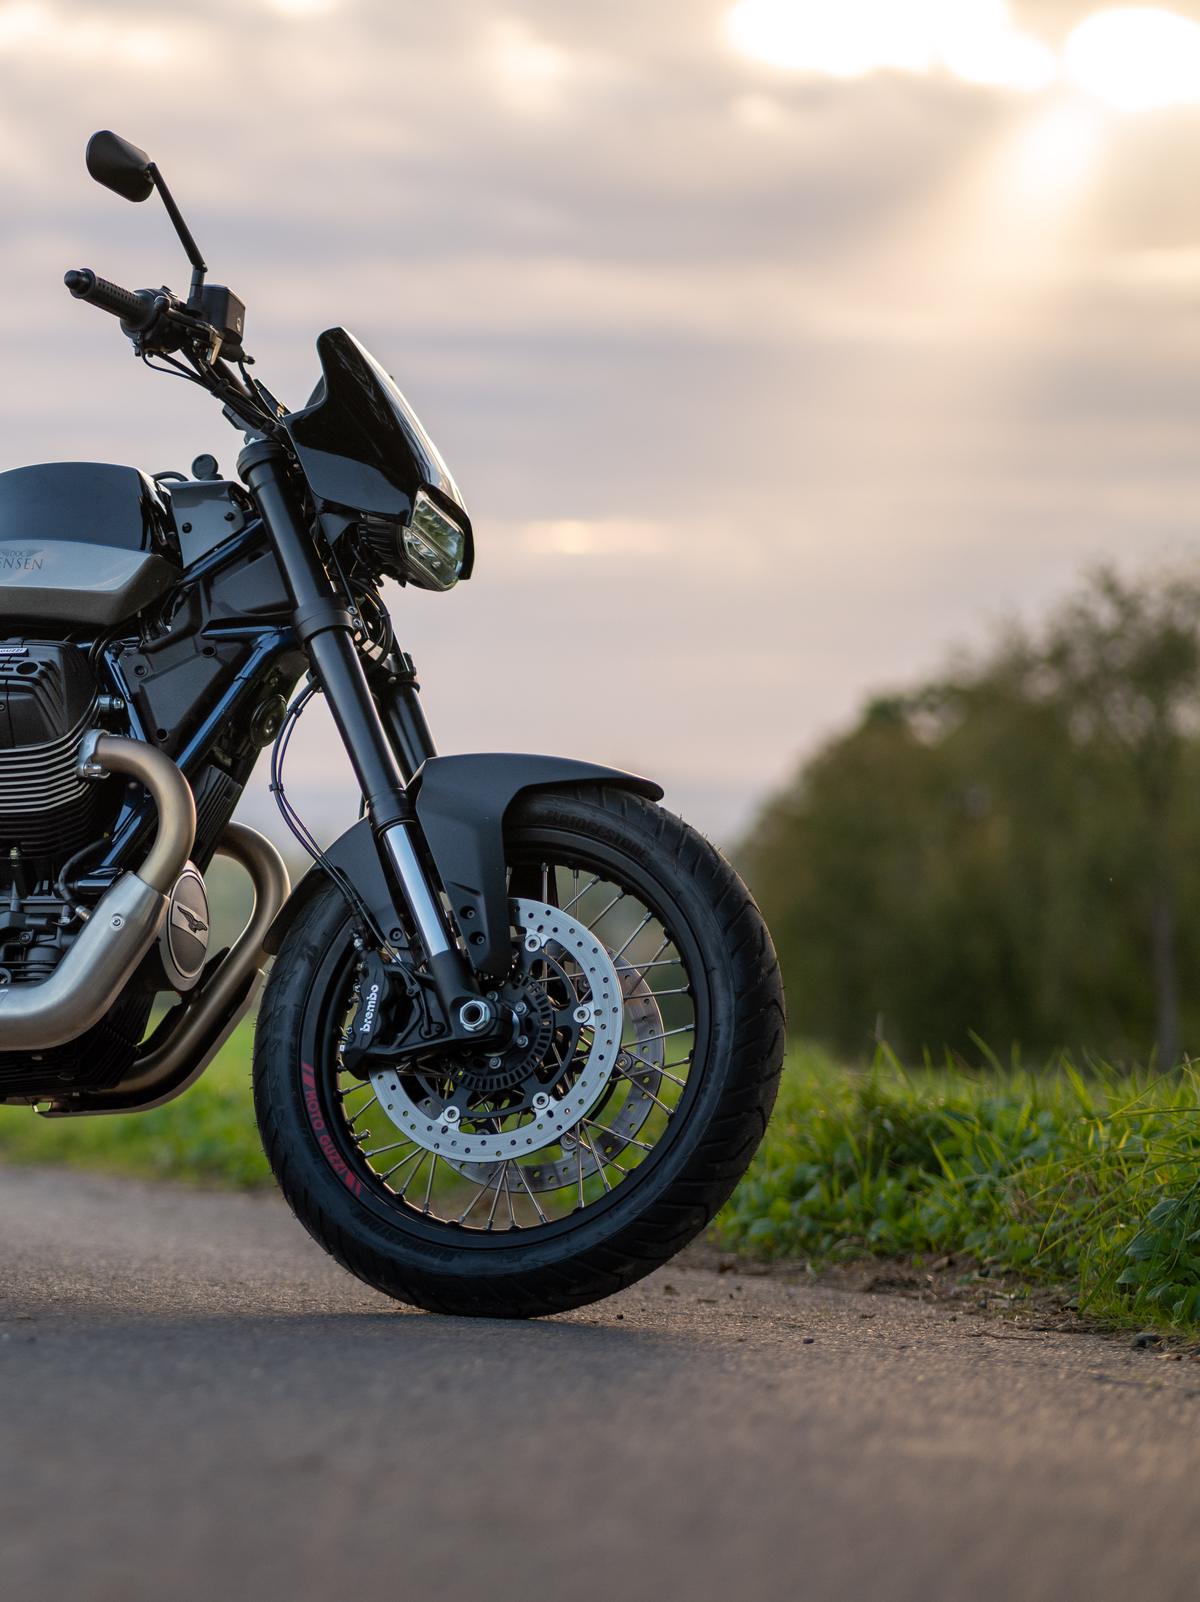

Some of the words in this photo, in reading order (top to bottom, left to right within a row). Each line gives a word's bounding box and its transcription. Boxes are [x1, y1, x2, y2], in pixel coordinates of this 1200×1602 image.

[360, 984, 379, 1032] brembo
[305, 1090, 324, 1130] MOTO
[320, 1135, 348, 1174] GUZZI
